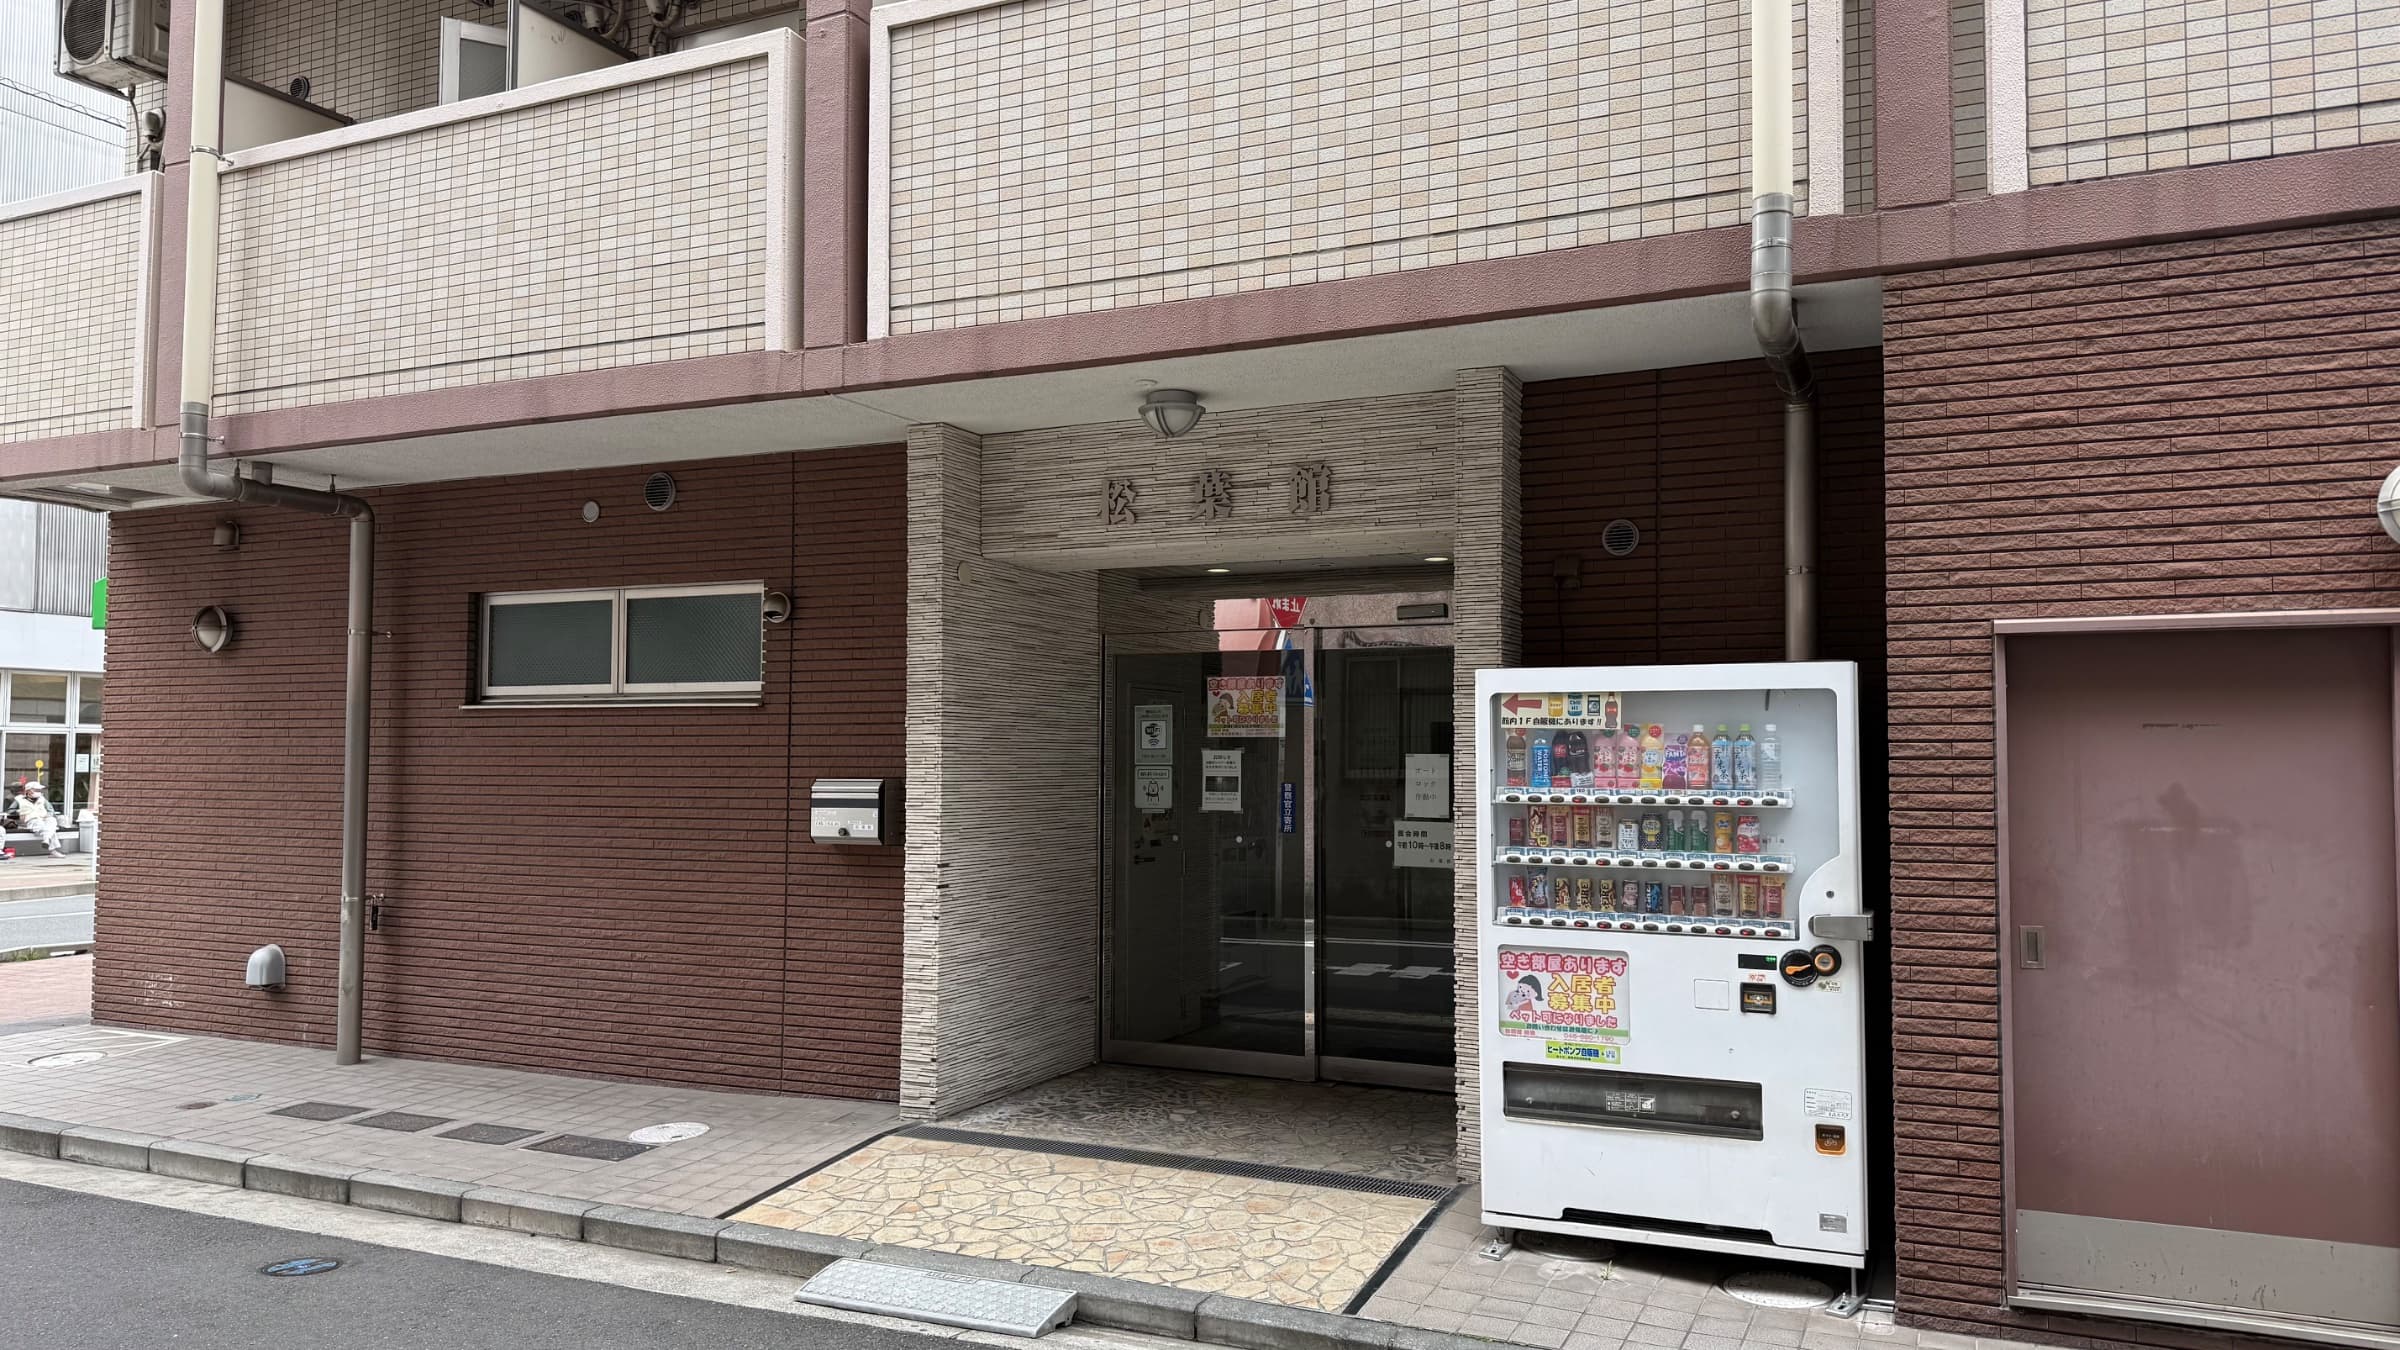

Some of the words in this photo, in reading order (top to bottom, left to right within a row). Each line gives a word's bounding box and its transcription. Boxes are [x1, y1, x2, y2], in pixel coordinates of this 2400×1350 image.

[1097, 463, 1333, 525] 松葉館
[1237, 689, 1278, 703] 入居者
[1500, 951, 1627, 976] 空き部屋あります
[1548, 973, 1617, 996] 入居者
[1548, 992, 1616, 1014] 募集中
[1510, 1010, 1618, 1029] ペット可になりました
